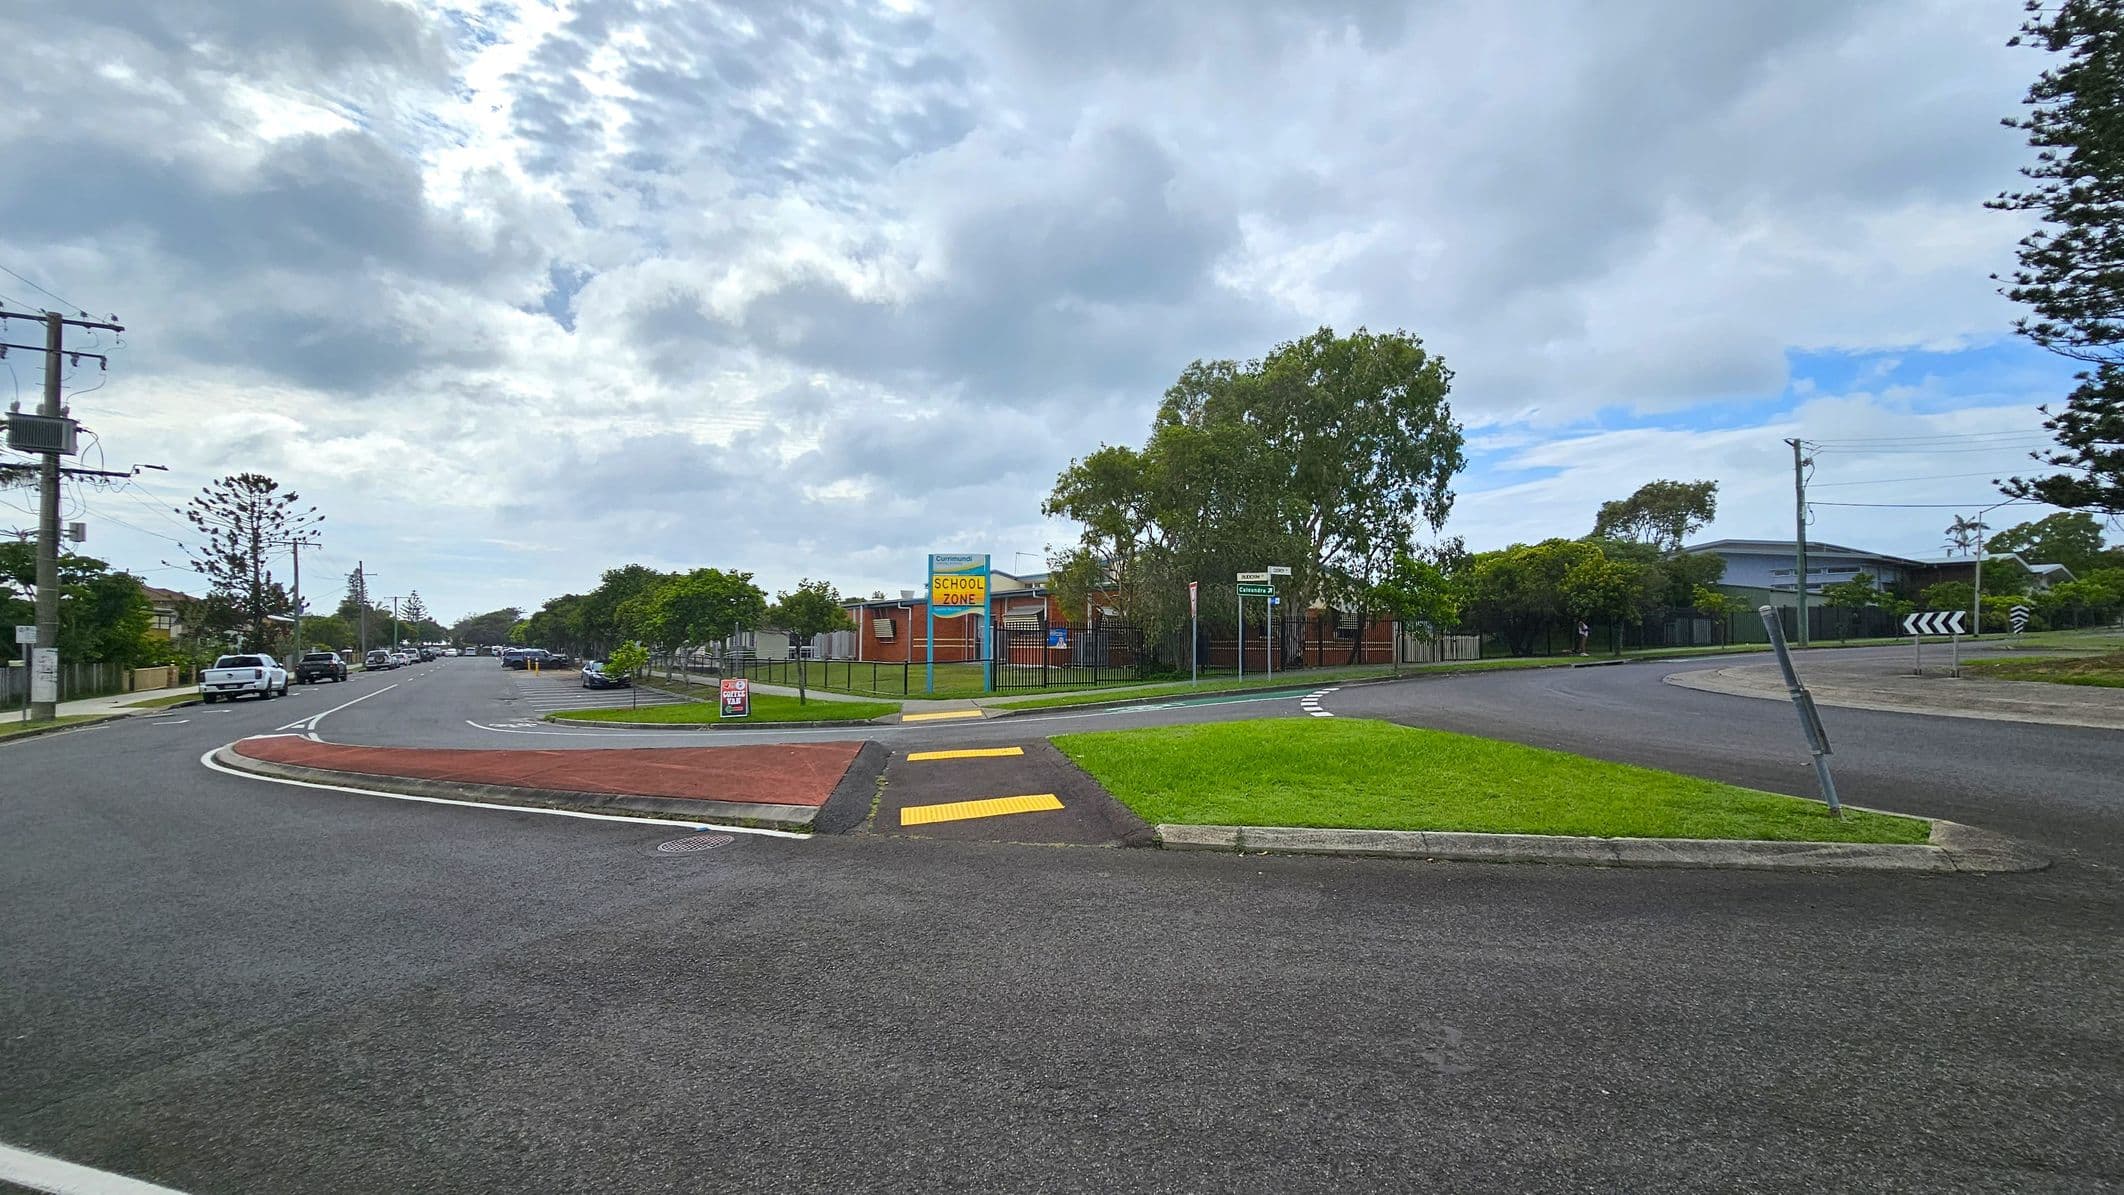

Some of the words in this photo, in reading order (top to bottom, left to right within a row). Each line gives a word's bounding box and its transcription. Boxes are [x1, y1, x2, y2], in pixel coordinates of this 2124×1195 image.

[934, 578, 984, 590] SCHOOL
[943, 593, 976, 605] ZONE
[723, 690, 746, 698] COFFEE
[727, 697, 742, 705] VAN
